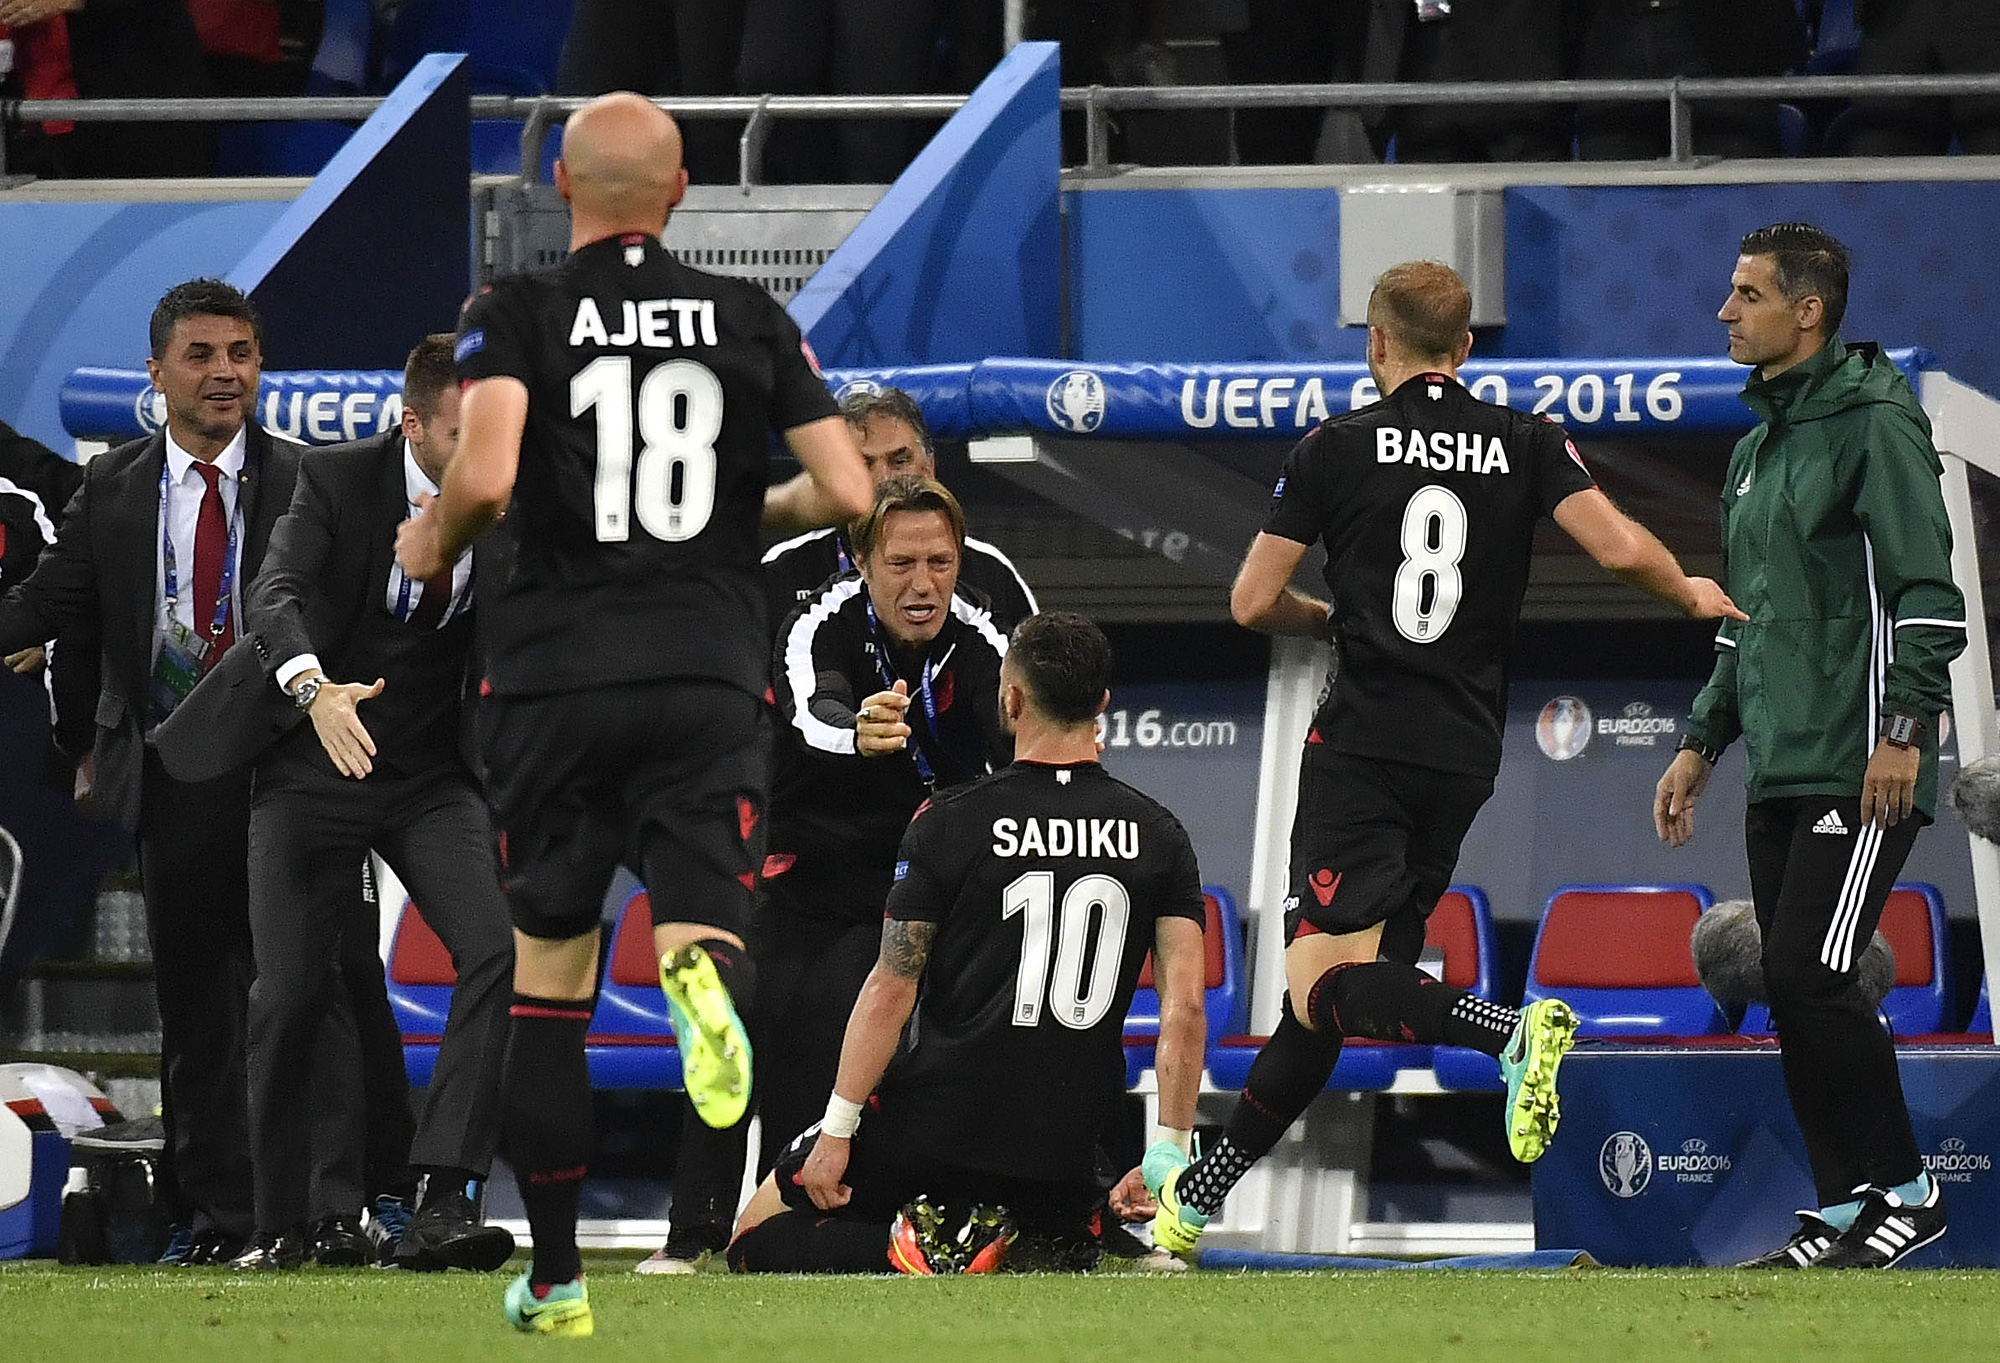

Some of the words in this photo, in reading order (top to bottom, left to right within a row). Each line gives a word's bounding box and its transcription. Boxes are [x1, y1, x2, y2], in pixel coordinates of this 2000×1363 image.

[569, 297, 718, 348] AJETI
[265, 391, 403, 441] UEFA
[1178, 377, 1330, 428] UEFA
[1532, 372, 1683, 424] 2016
[570, 355, 725, 542] 18
[1376, 427, 1510, 474] BASHA
[1392, 485, 1468, 644] 8
[1598, 718, 1675, 734] EURO2016
[1616, 735, 1655, 746] FRANCE
[993, 817, 1139, 859] SADIKU
[1812, 825, 1849, 835] adidas
[1003, 871, 1130, 1030] 10
[1658, 1155, 1731, 1171] EURO2016
[1676, 1173, 1713, 1183] FRANCE
